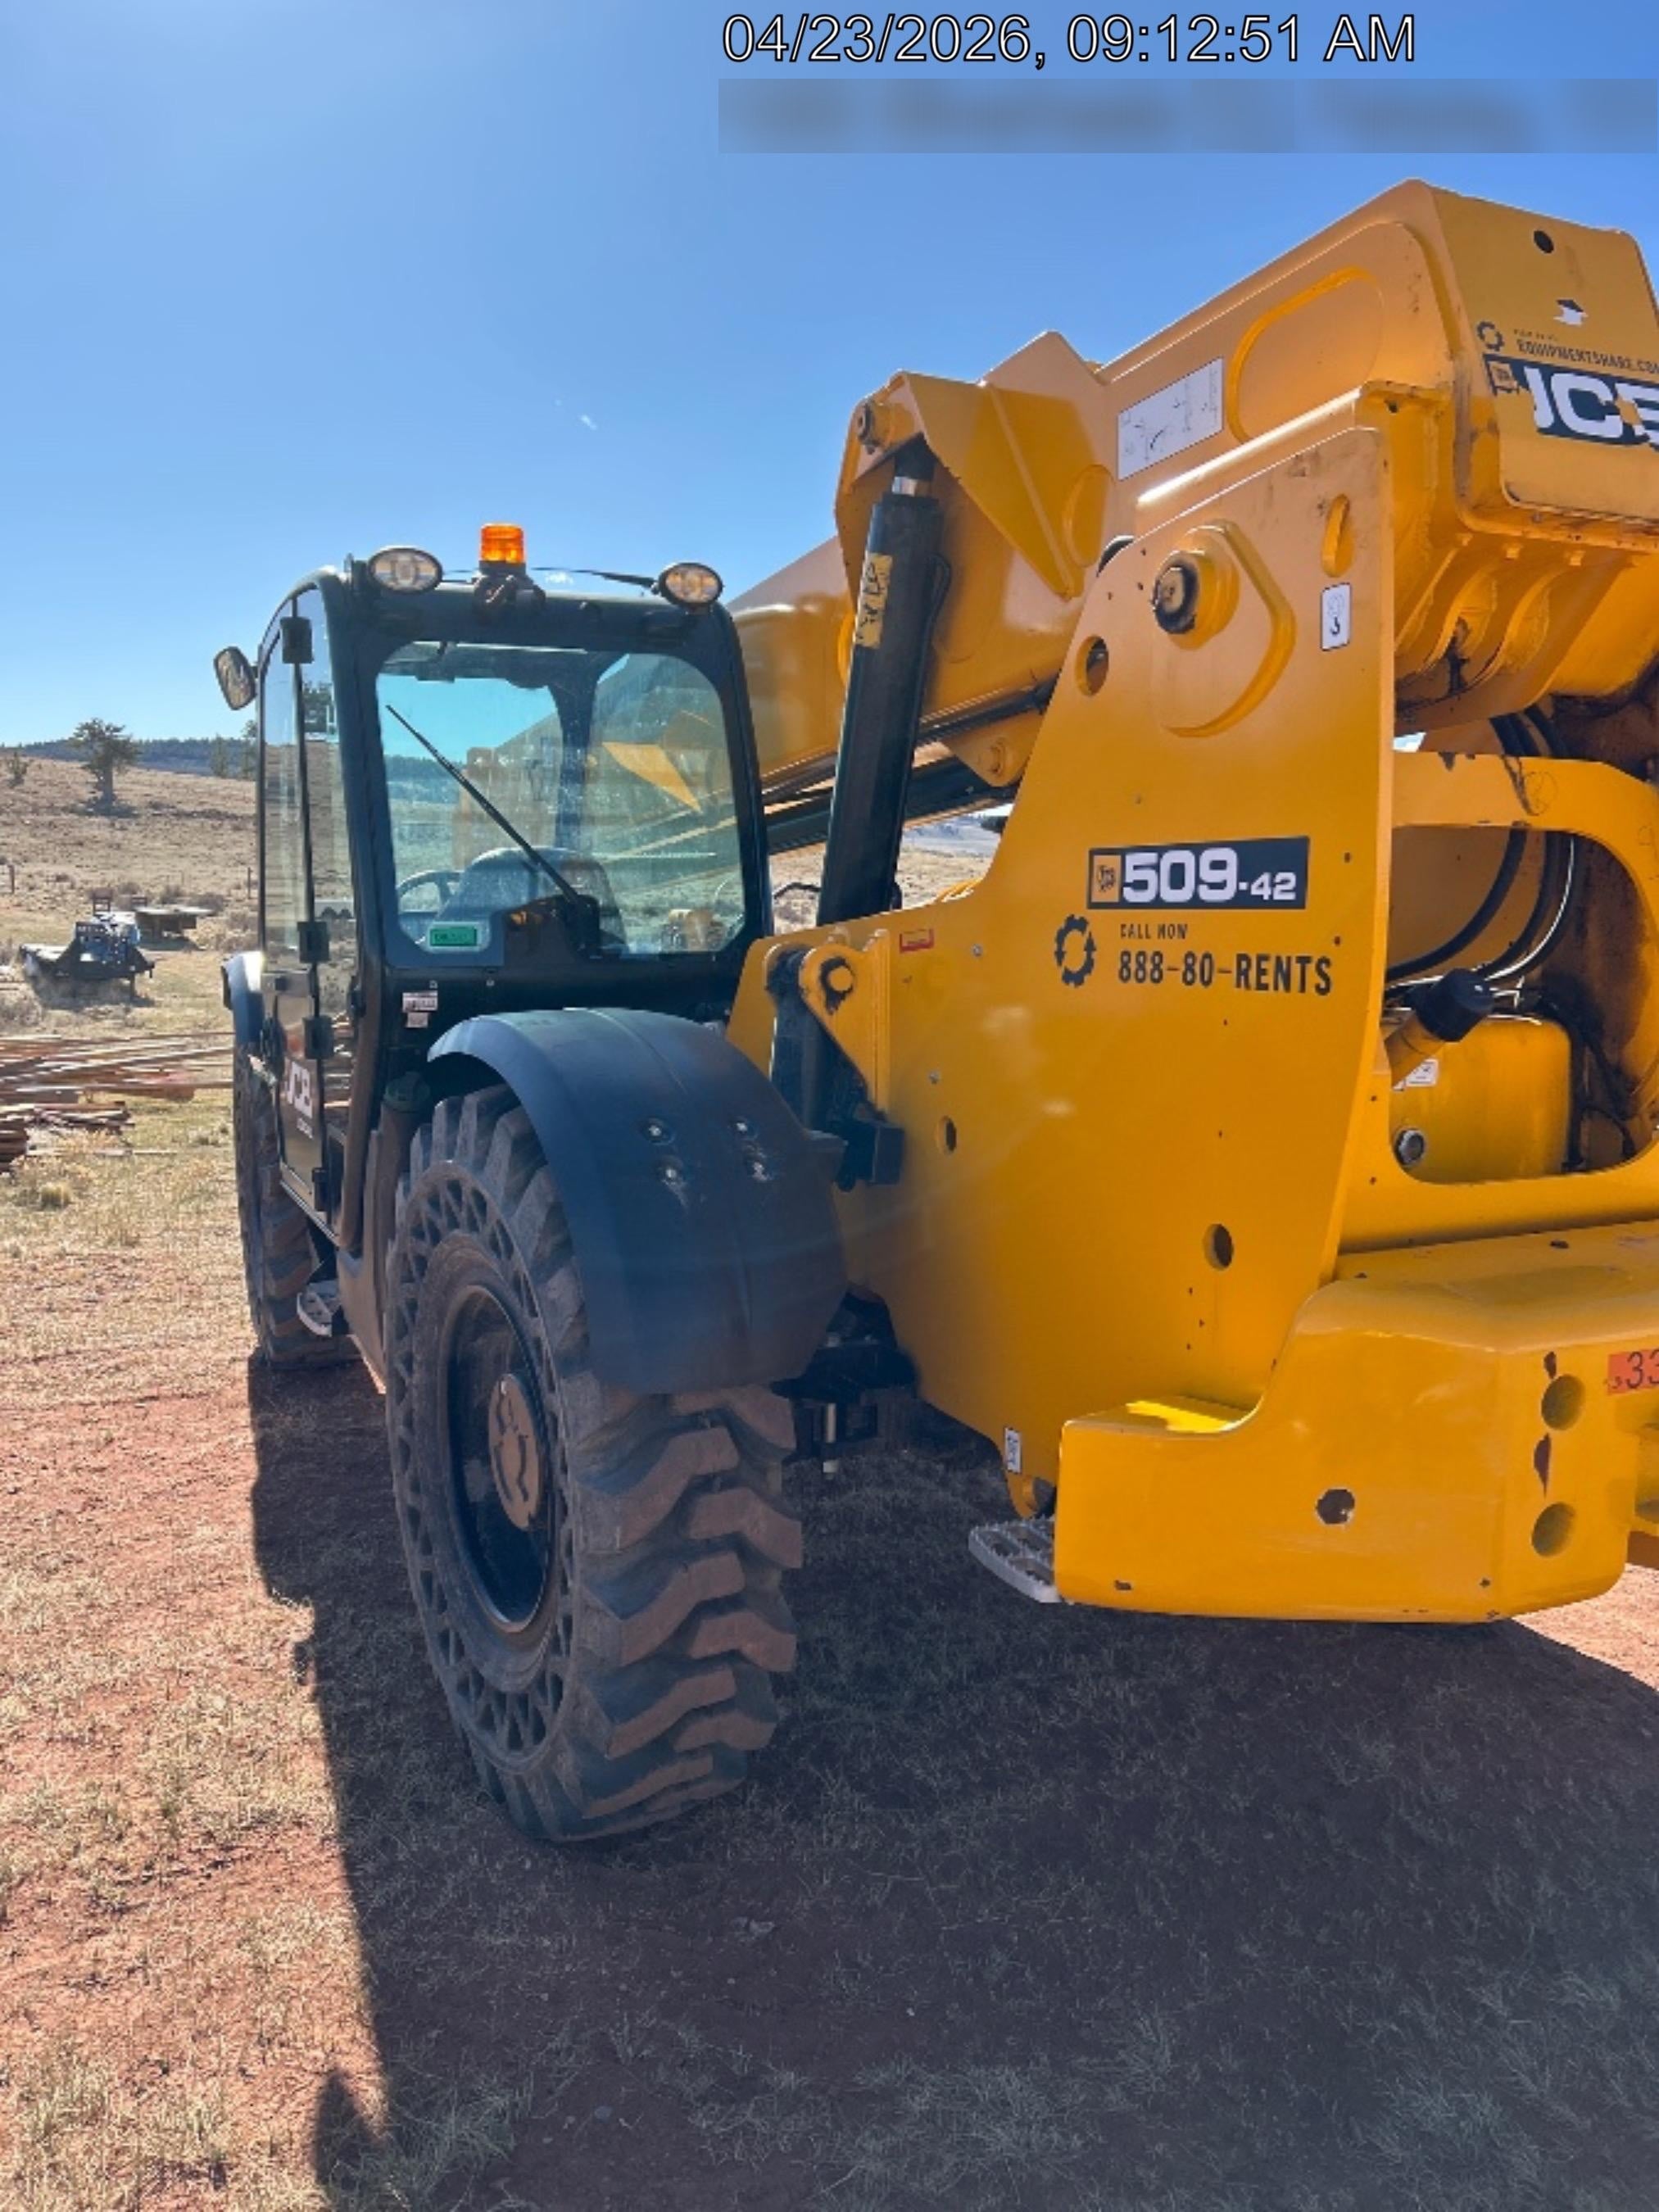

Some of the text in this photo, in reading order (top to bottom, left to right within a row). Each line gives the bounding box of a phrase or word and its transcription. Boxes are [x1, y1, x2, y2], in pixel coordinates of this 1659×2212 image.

[1122, 847, 1296, 903] 509-42
[1120, 923, 1189, 940] CALL NOW
[1118, 950, 1332, 996] 888-80-RENTS
